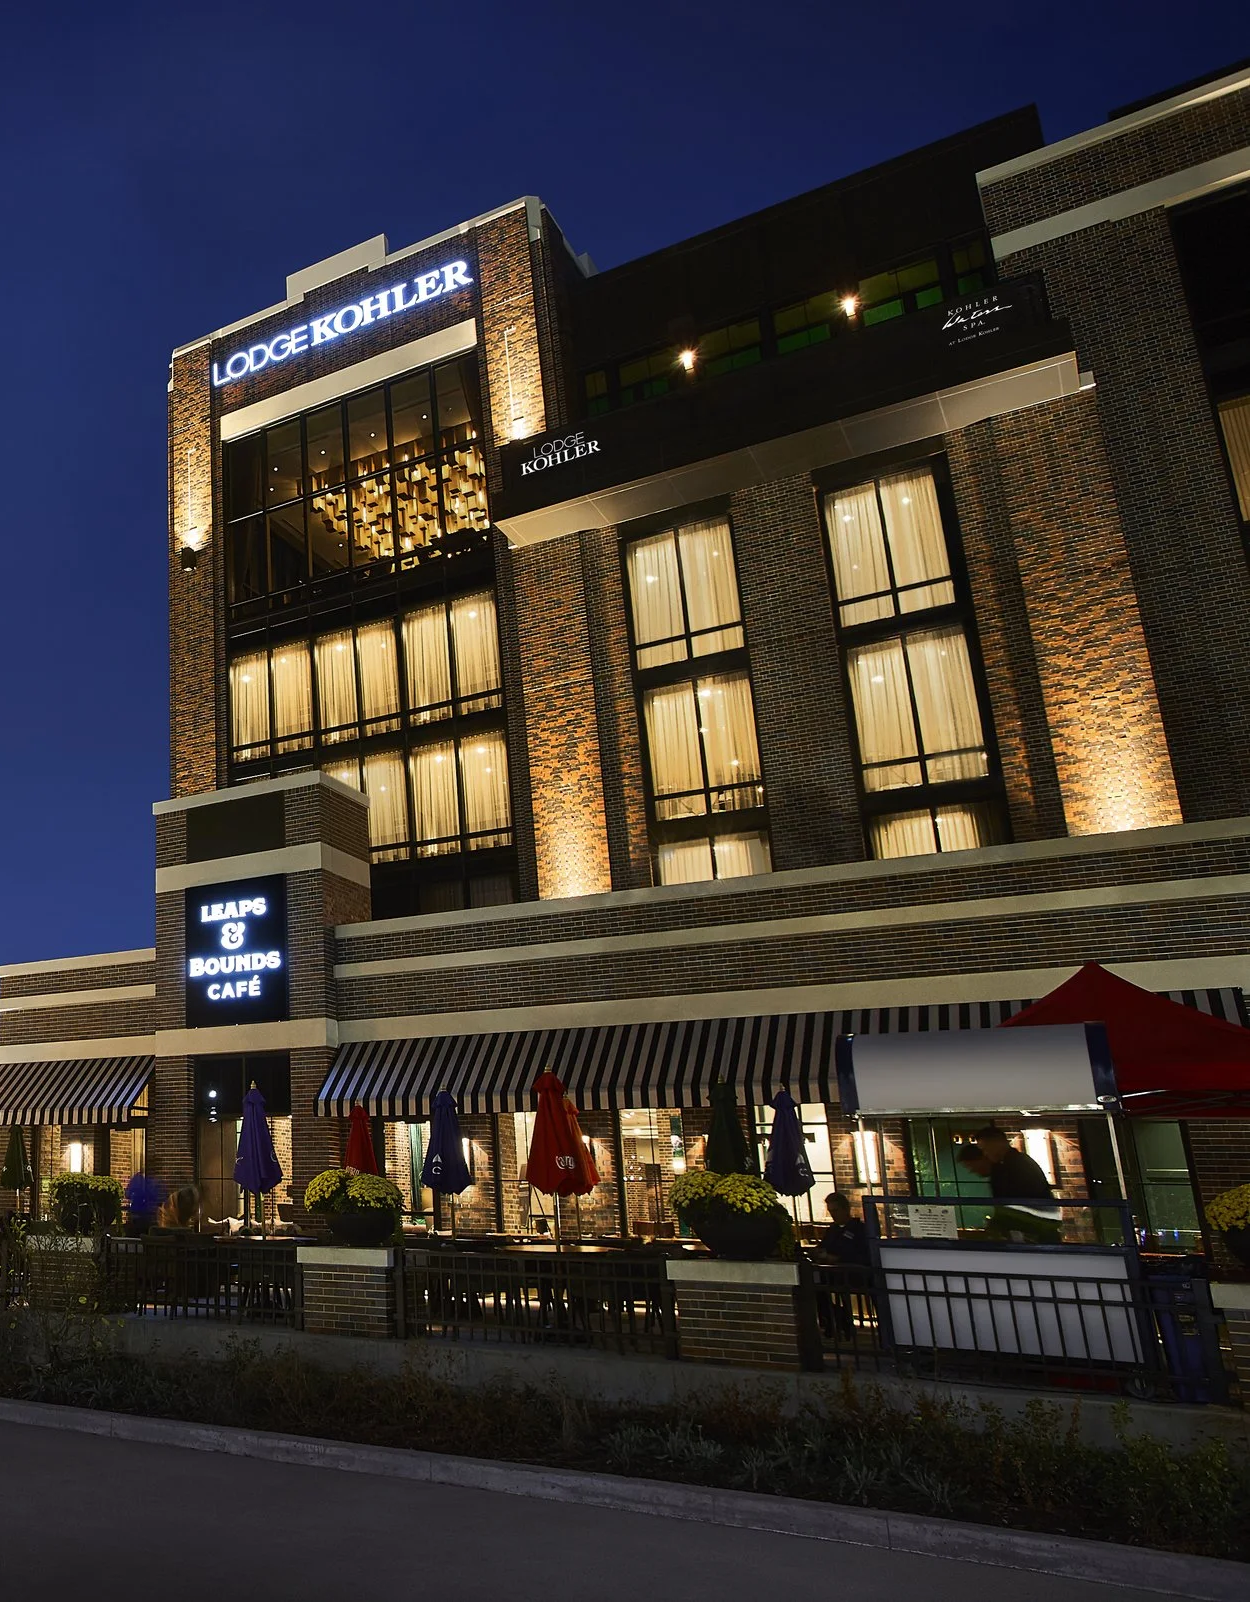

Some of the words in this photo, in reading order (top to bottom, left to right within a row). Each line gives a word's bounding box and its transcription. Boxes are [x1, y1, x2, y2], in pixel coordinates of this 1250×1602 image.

[947, 295, 998, 316] KOHLER
[213, 325, 308, 387] LODGE
[310, 260, 474, 346] KOHLER
[520, 440, 601, 476] KOHLER
[533, 431, 585, 459] LODGE
[200, 897, 267, 923] LEAPS
[220, 921, 246, 950] &
[189, 950, 282, 978] BOUNDS
[207, 974, 262, 1001] CAFÉ
